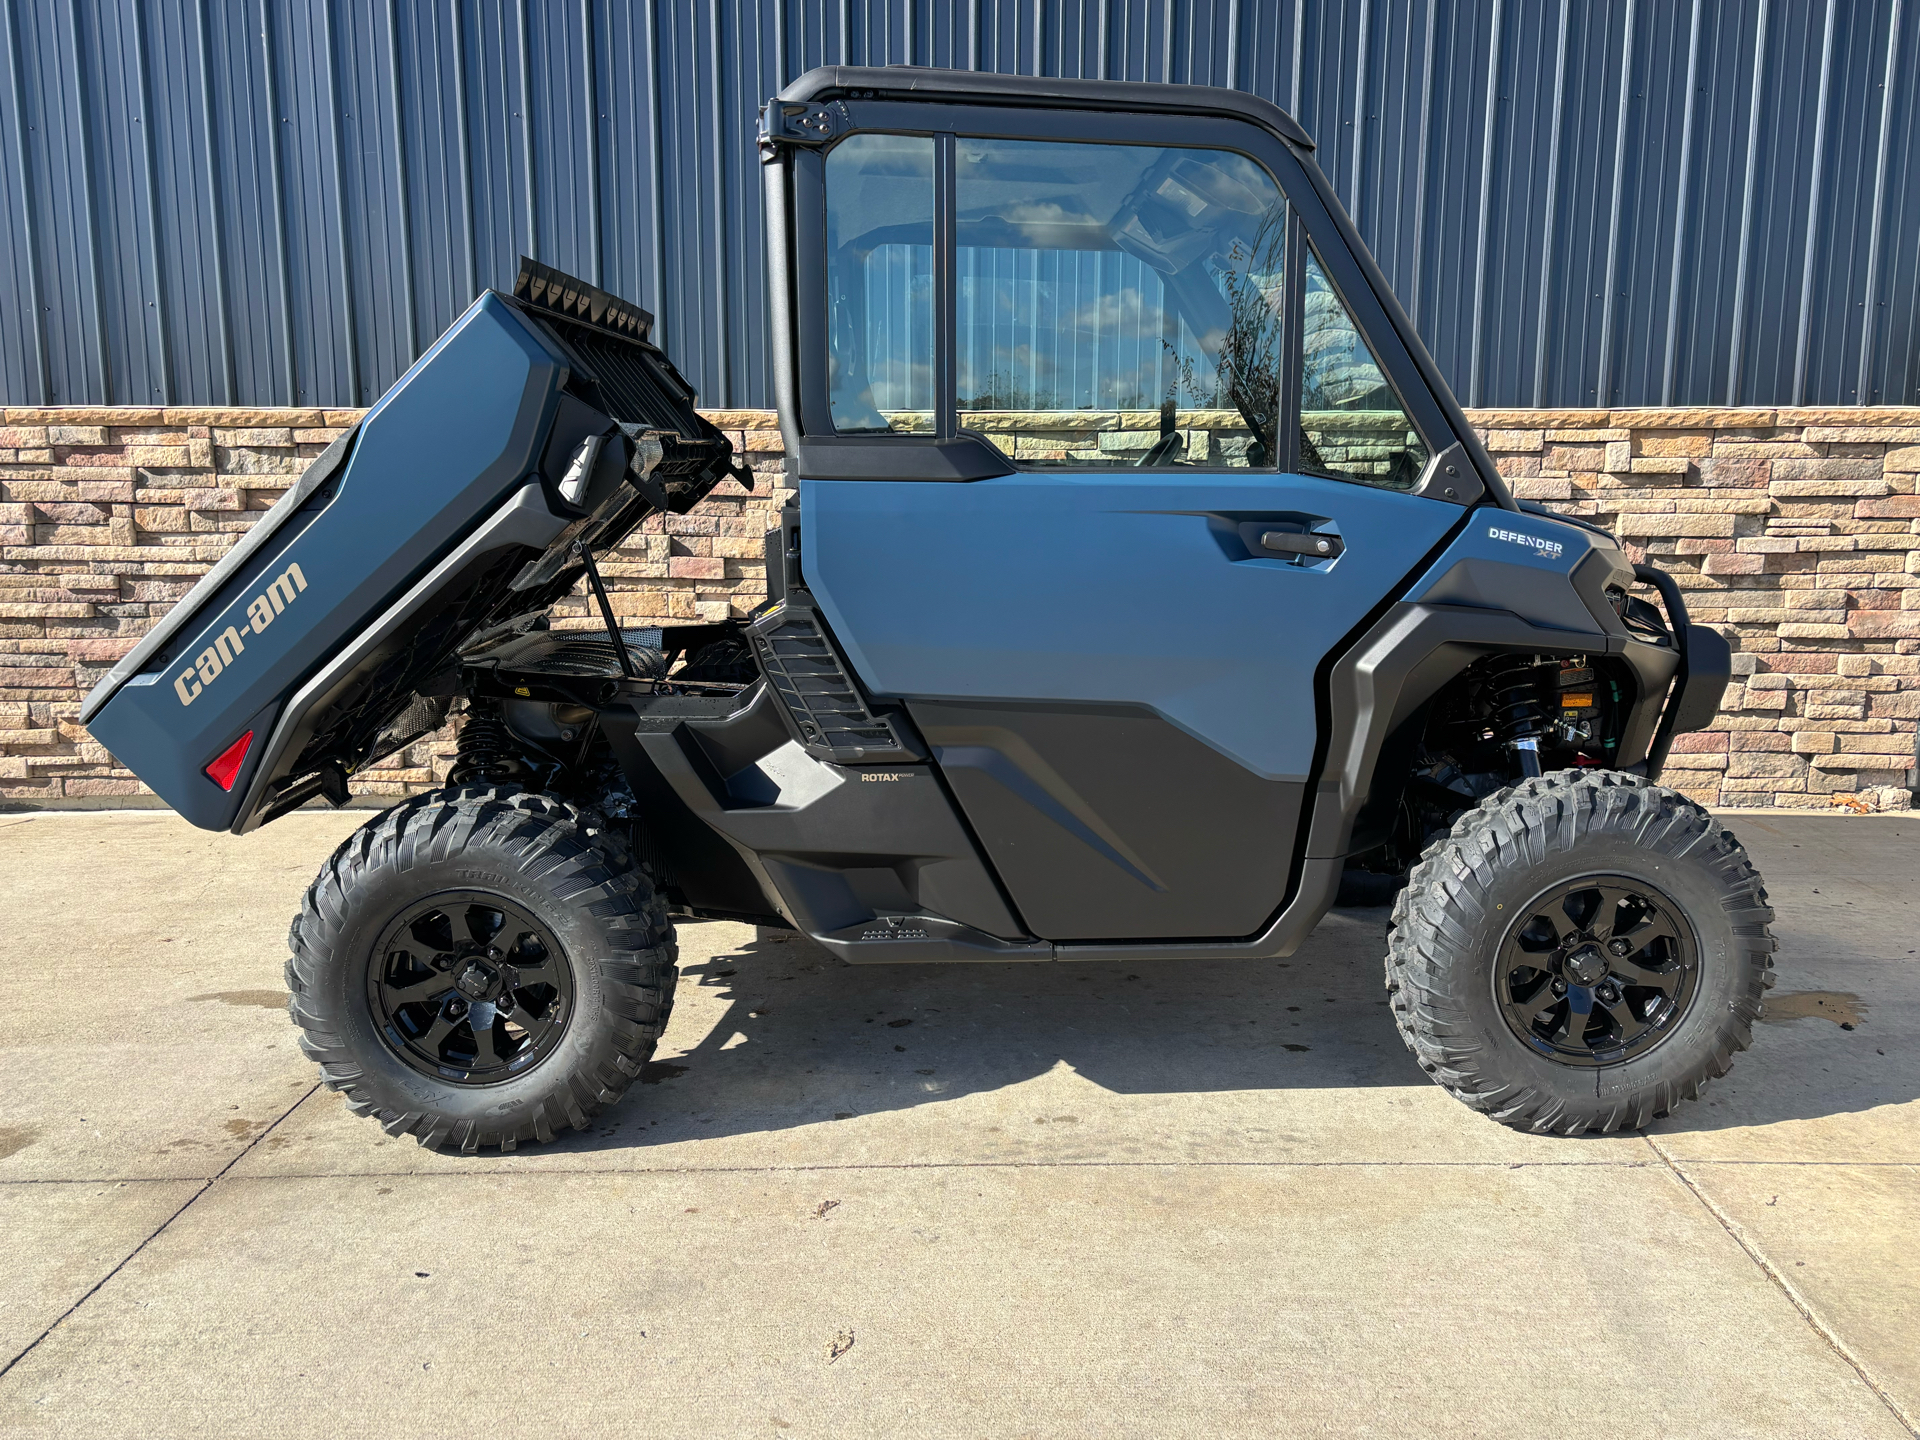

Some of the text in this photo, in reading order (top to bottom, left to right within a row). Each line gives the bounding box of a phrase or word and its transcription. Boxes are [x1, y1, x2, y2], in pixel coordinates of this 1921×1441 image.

[1489, 527, 1563, 553] DEFENDER
[1536, 549, 1561, 560] XT
[861, 773, 899, 782] ROTAX
[455, 868, 511, 886] TRAIL
[512, 881, 557, 914] KING
[1714, 937, 1727, 988] TRAIL
[1695, 990, 1722, 1035] KING
